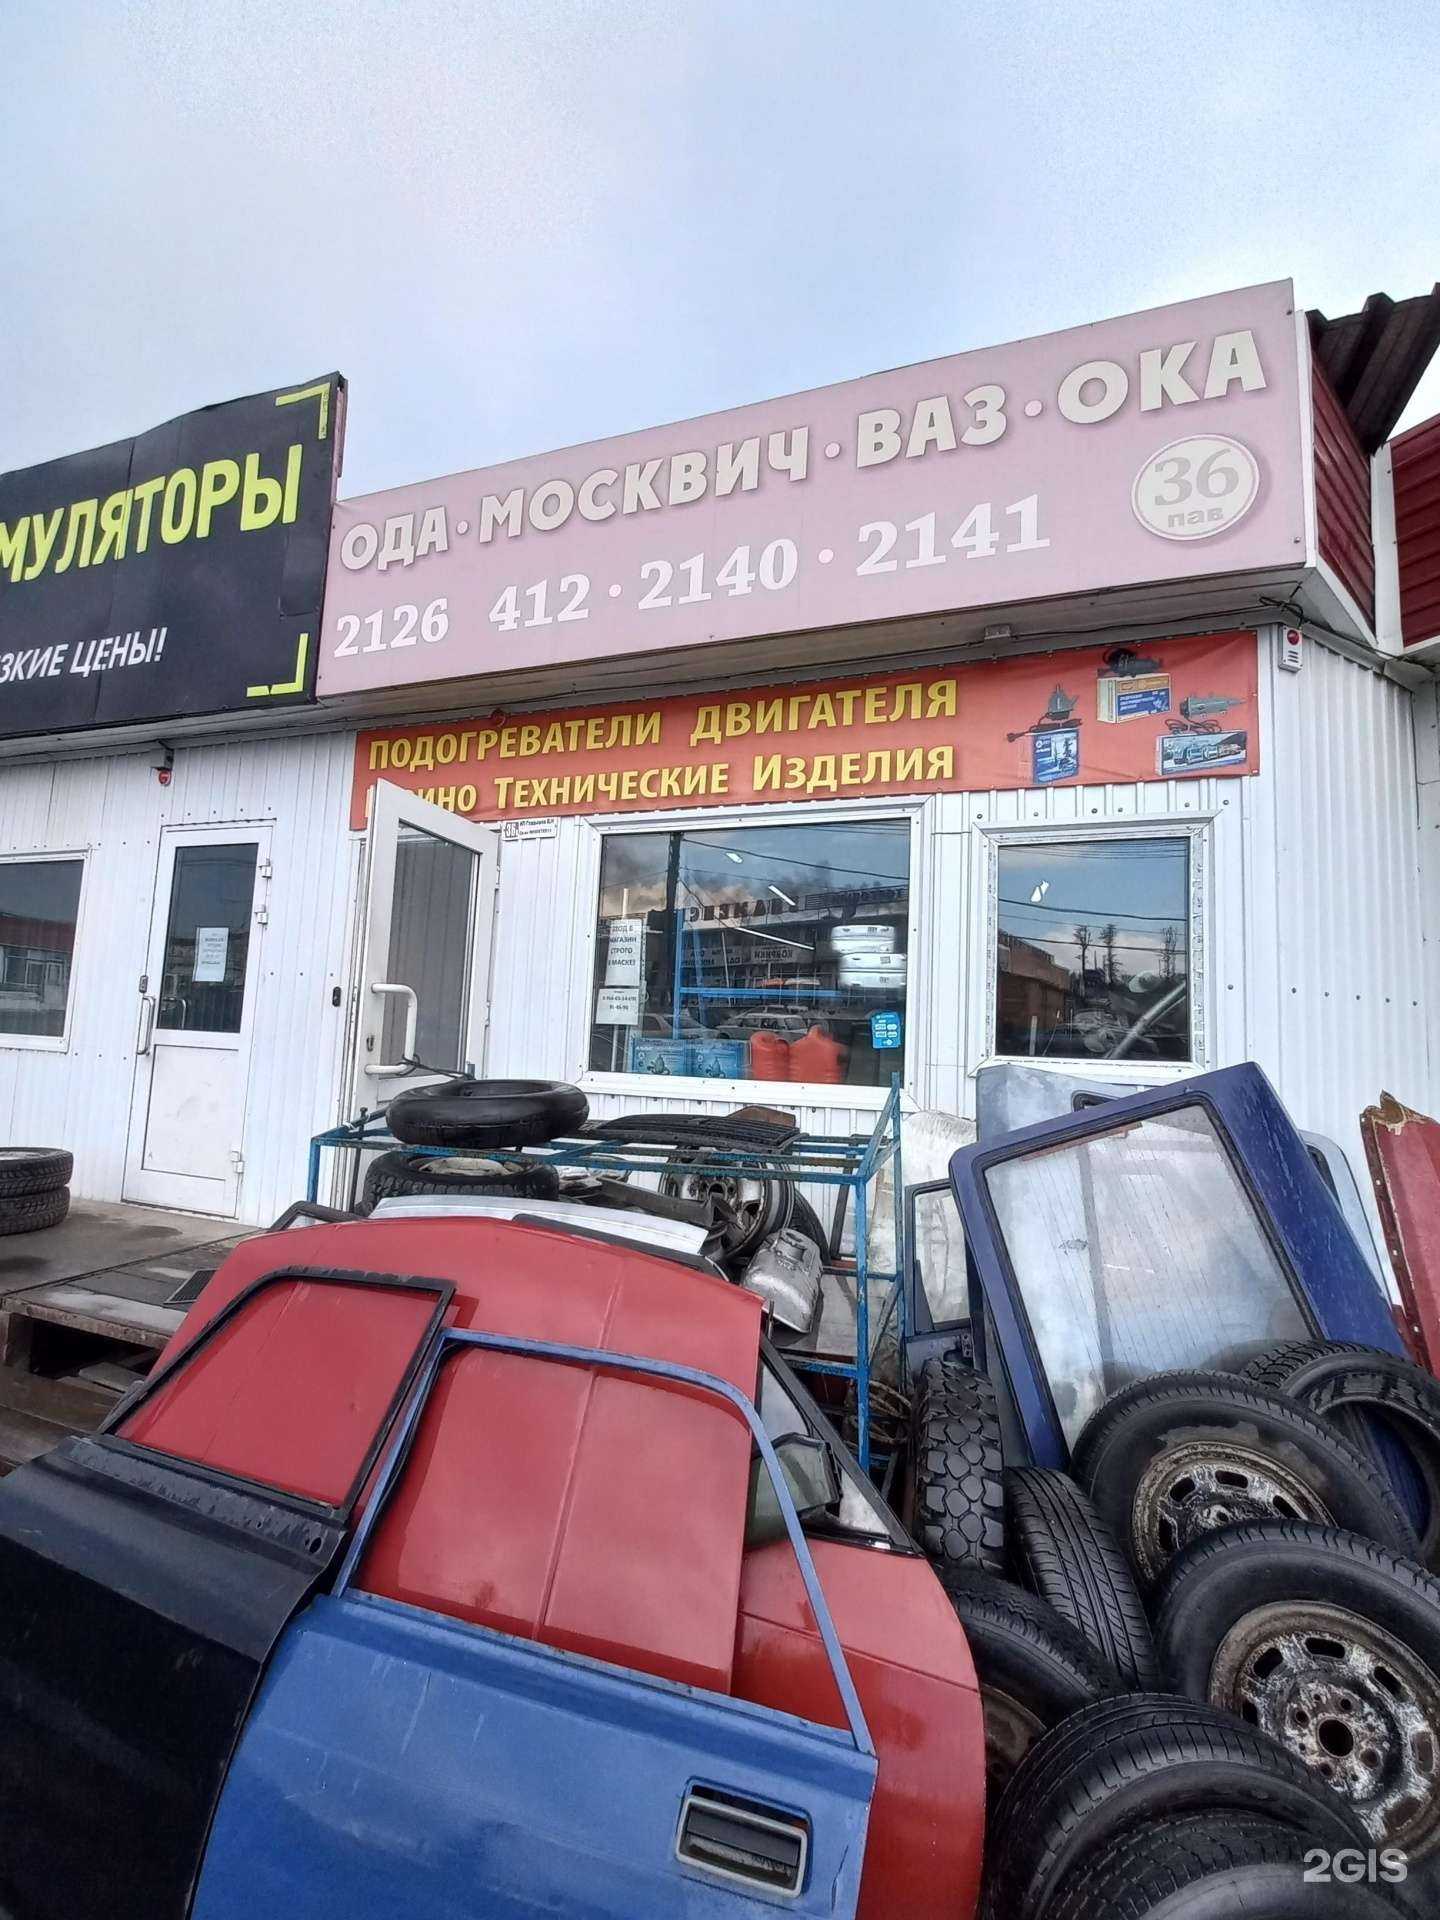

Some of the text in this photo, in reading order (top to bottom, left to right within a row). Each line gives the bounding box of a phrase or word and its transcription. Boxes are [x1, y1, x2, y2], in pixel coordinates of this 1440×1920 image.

[340, 330, 1268, 571] ОДА МОСКВИЧ ВАЗ ОКА
[1153, 447, 1241, 507] 36
[0, 444, 303, 583] МУЛЯТОРЫ
[333, 493, 1051, 658] 2126 412 2140 2141
[69, 627, 167, 678] ЦЕНЫ!
[368, 679, 957, 772] ПОДОГРЕВАТЕЛИ ДВИГАТЕЛЯ
